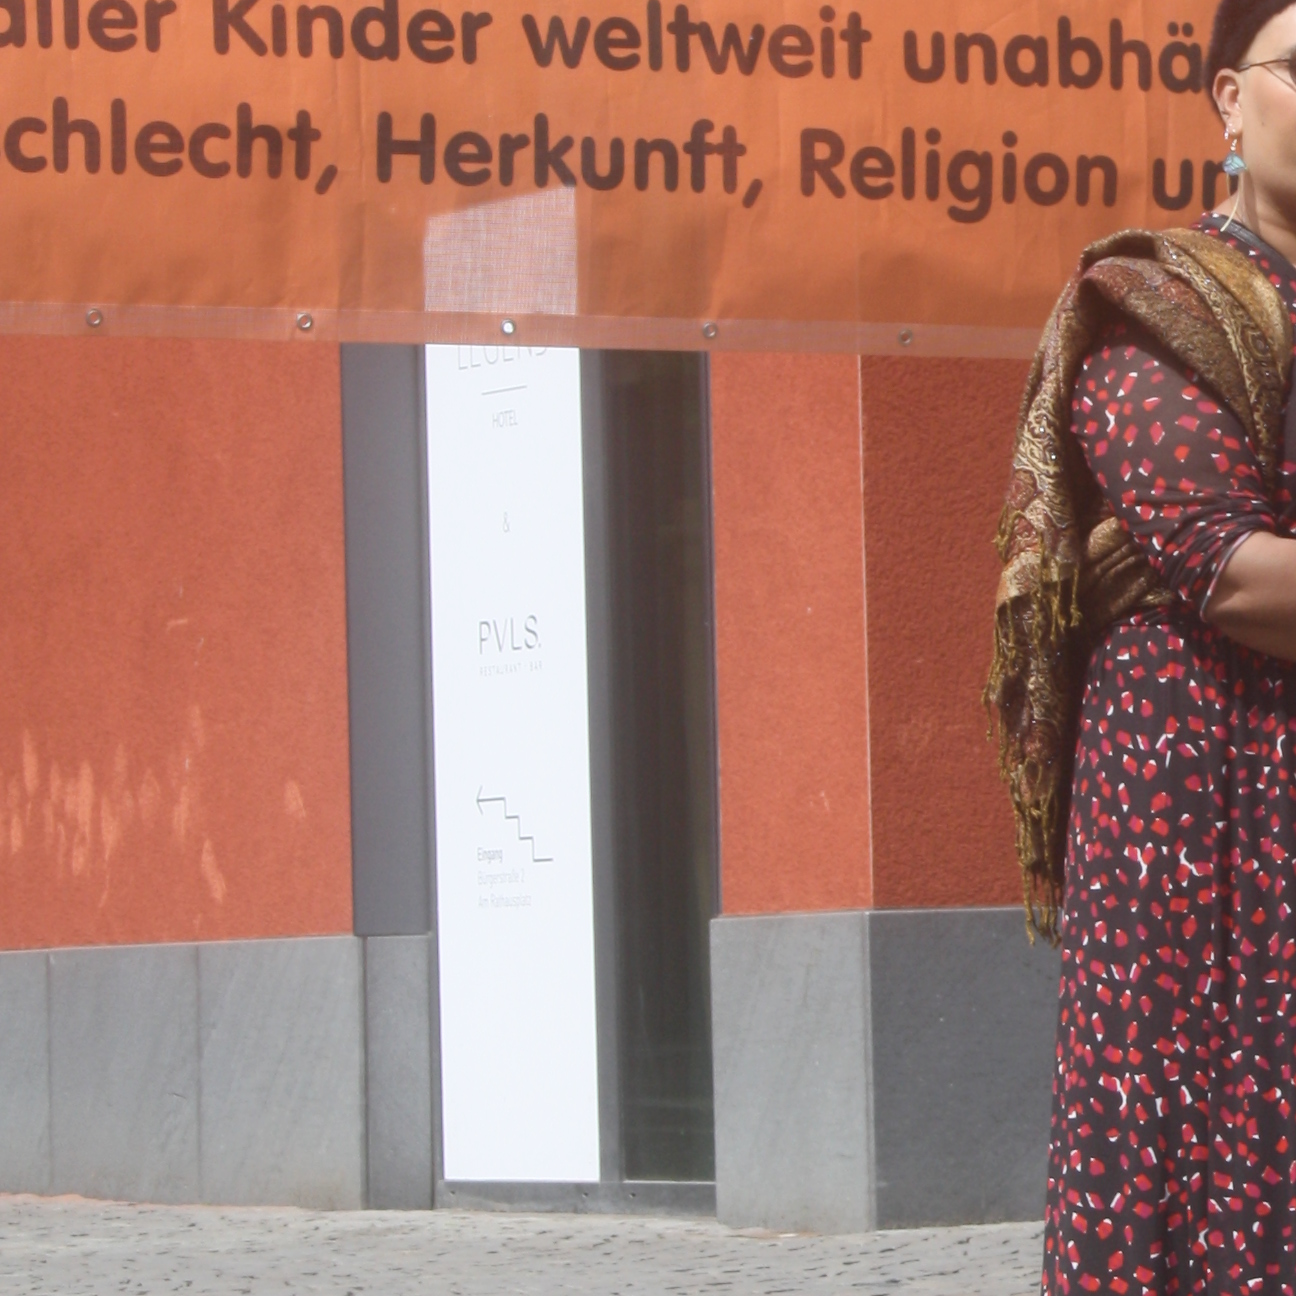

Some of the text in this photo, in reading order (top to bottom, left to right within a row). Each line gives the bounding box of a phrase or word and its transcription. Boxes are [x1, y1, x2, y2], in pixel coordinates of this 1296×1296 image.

[903, 12, 1206, 98] unabhä
[0, 96, 339, 197] chlecht,
[376, 110, 764, 210] Herkunft,
[799, 126, 1119, 225] Religion
[1151, 157, 1241, 214] un
[492, 408, 520, 430] HOTEL
[502, 510, 512, 534] &
[478, 613, 542, 655] PVLS.
[479, 659, 543, 678] RESTAURANT BAR
[477, 846, 504, 865] Eingang
